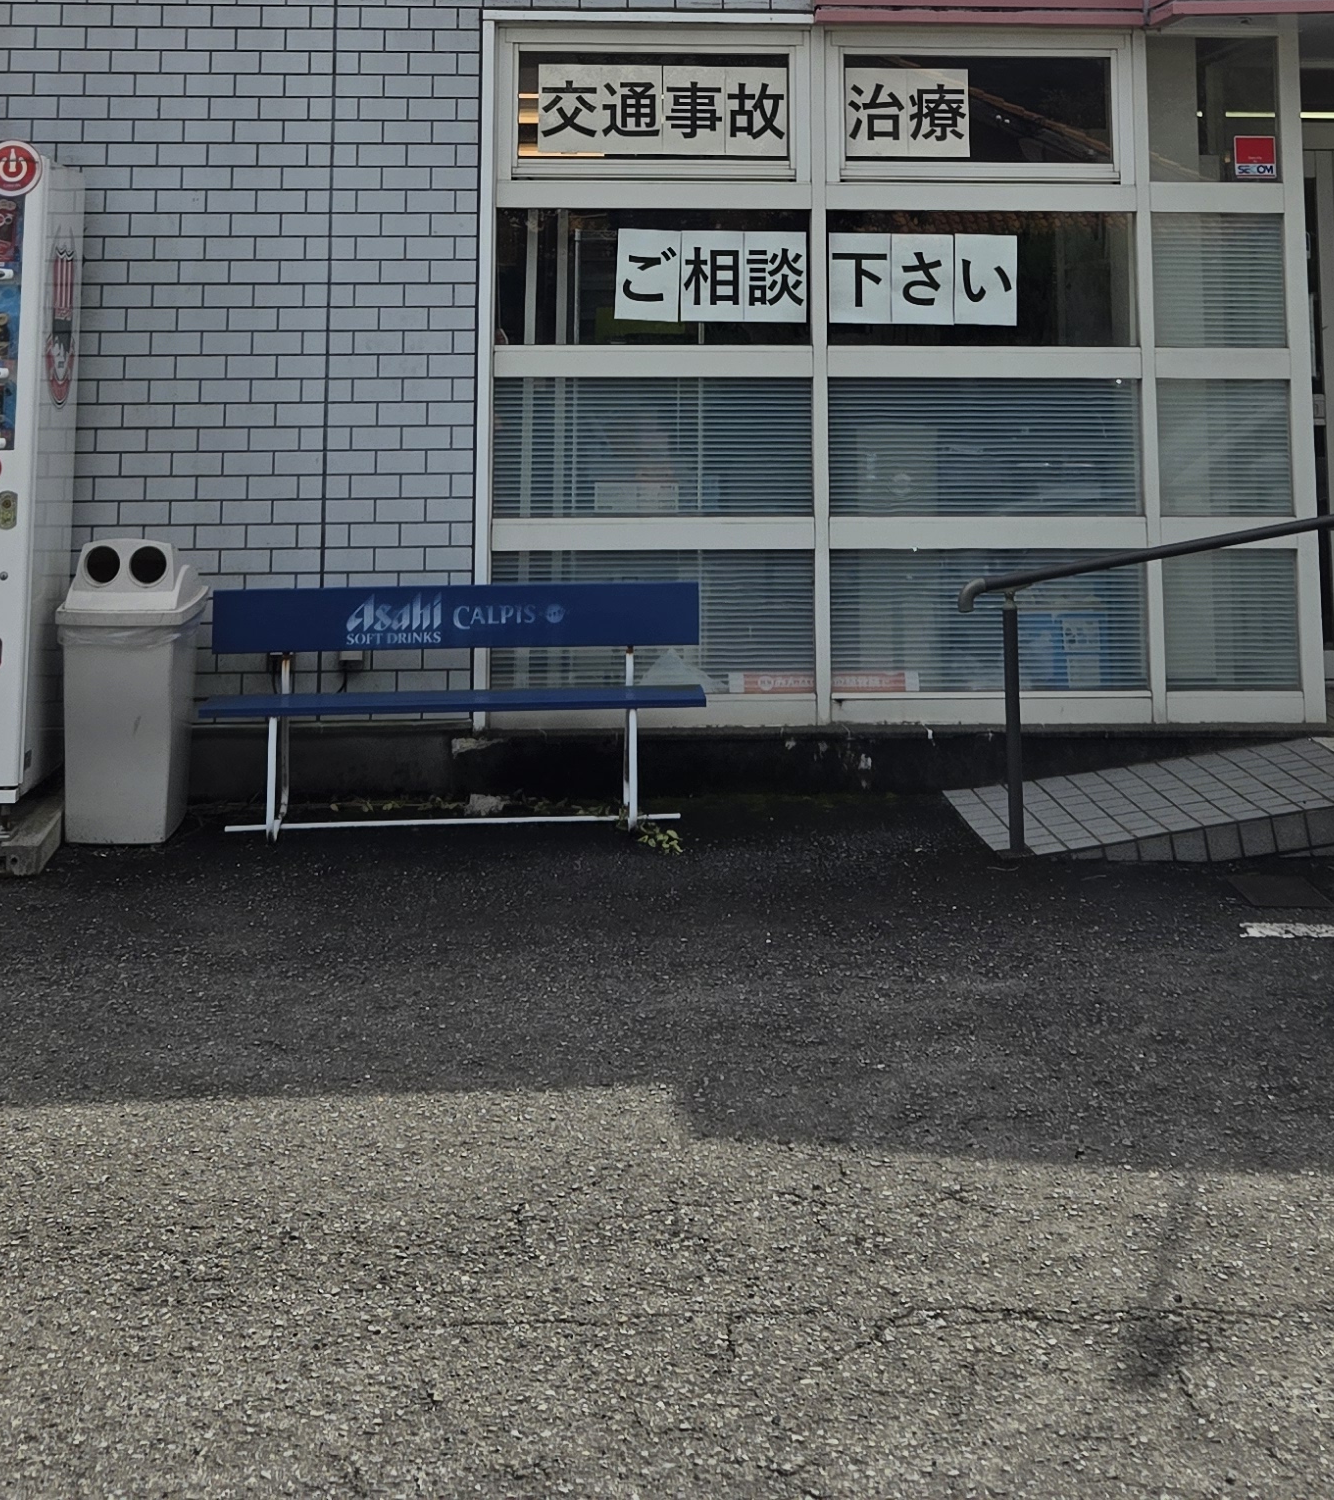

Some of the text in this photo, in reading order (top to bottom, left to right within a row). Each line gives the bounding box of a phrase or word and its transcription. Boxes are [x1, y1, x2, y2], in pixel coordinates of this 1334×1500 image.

[541, 81, 967, 142] 交通事故 治療
[1237, 164, 1274, 174] SECOM
[622, 246, 1013, 307] ご相談 下さい
[346, 592, 442, 631] Asahi
[452, 604, 536, 630] CALPIS
[346, 631, 441, 645] SOFT DRINKS
